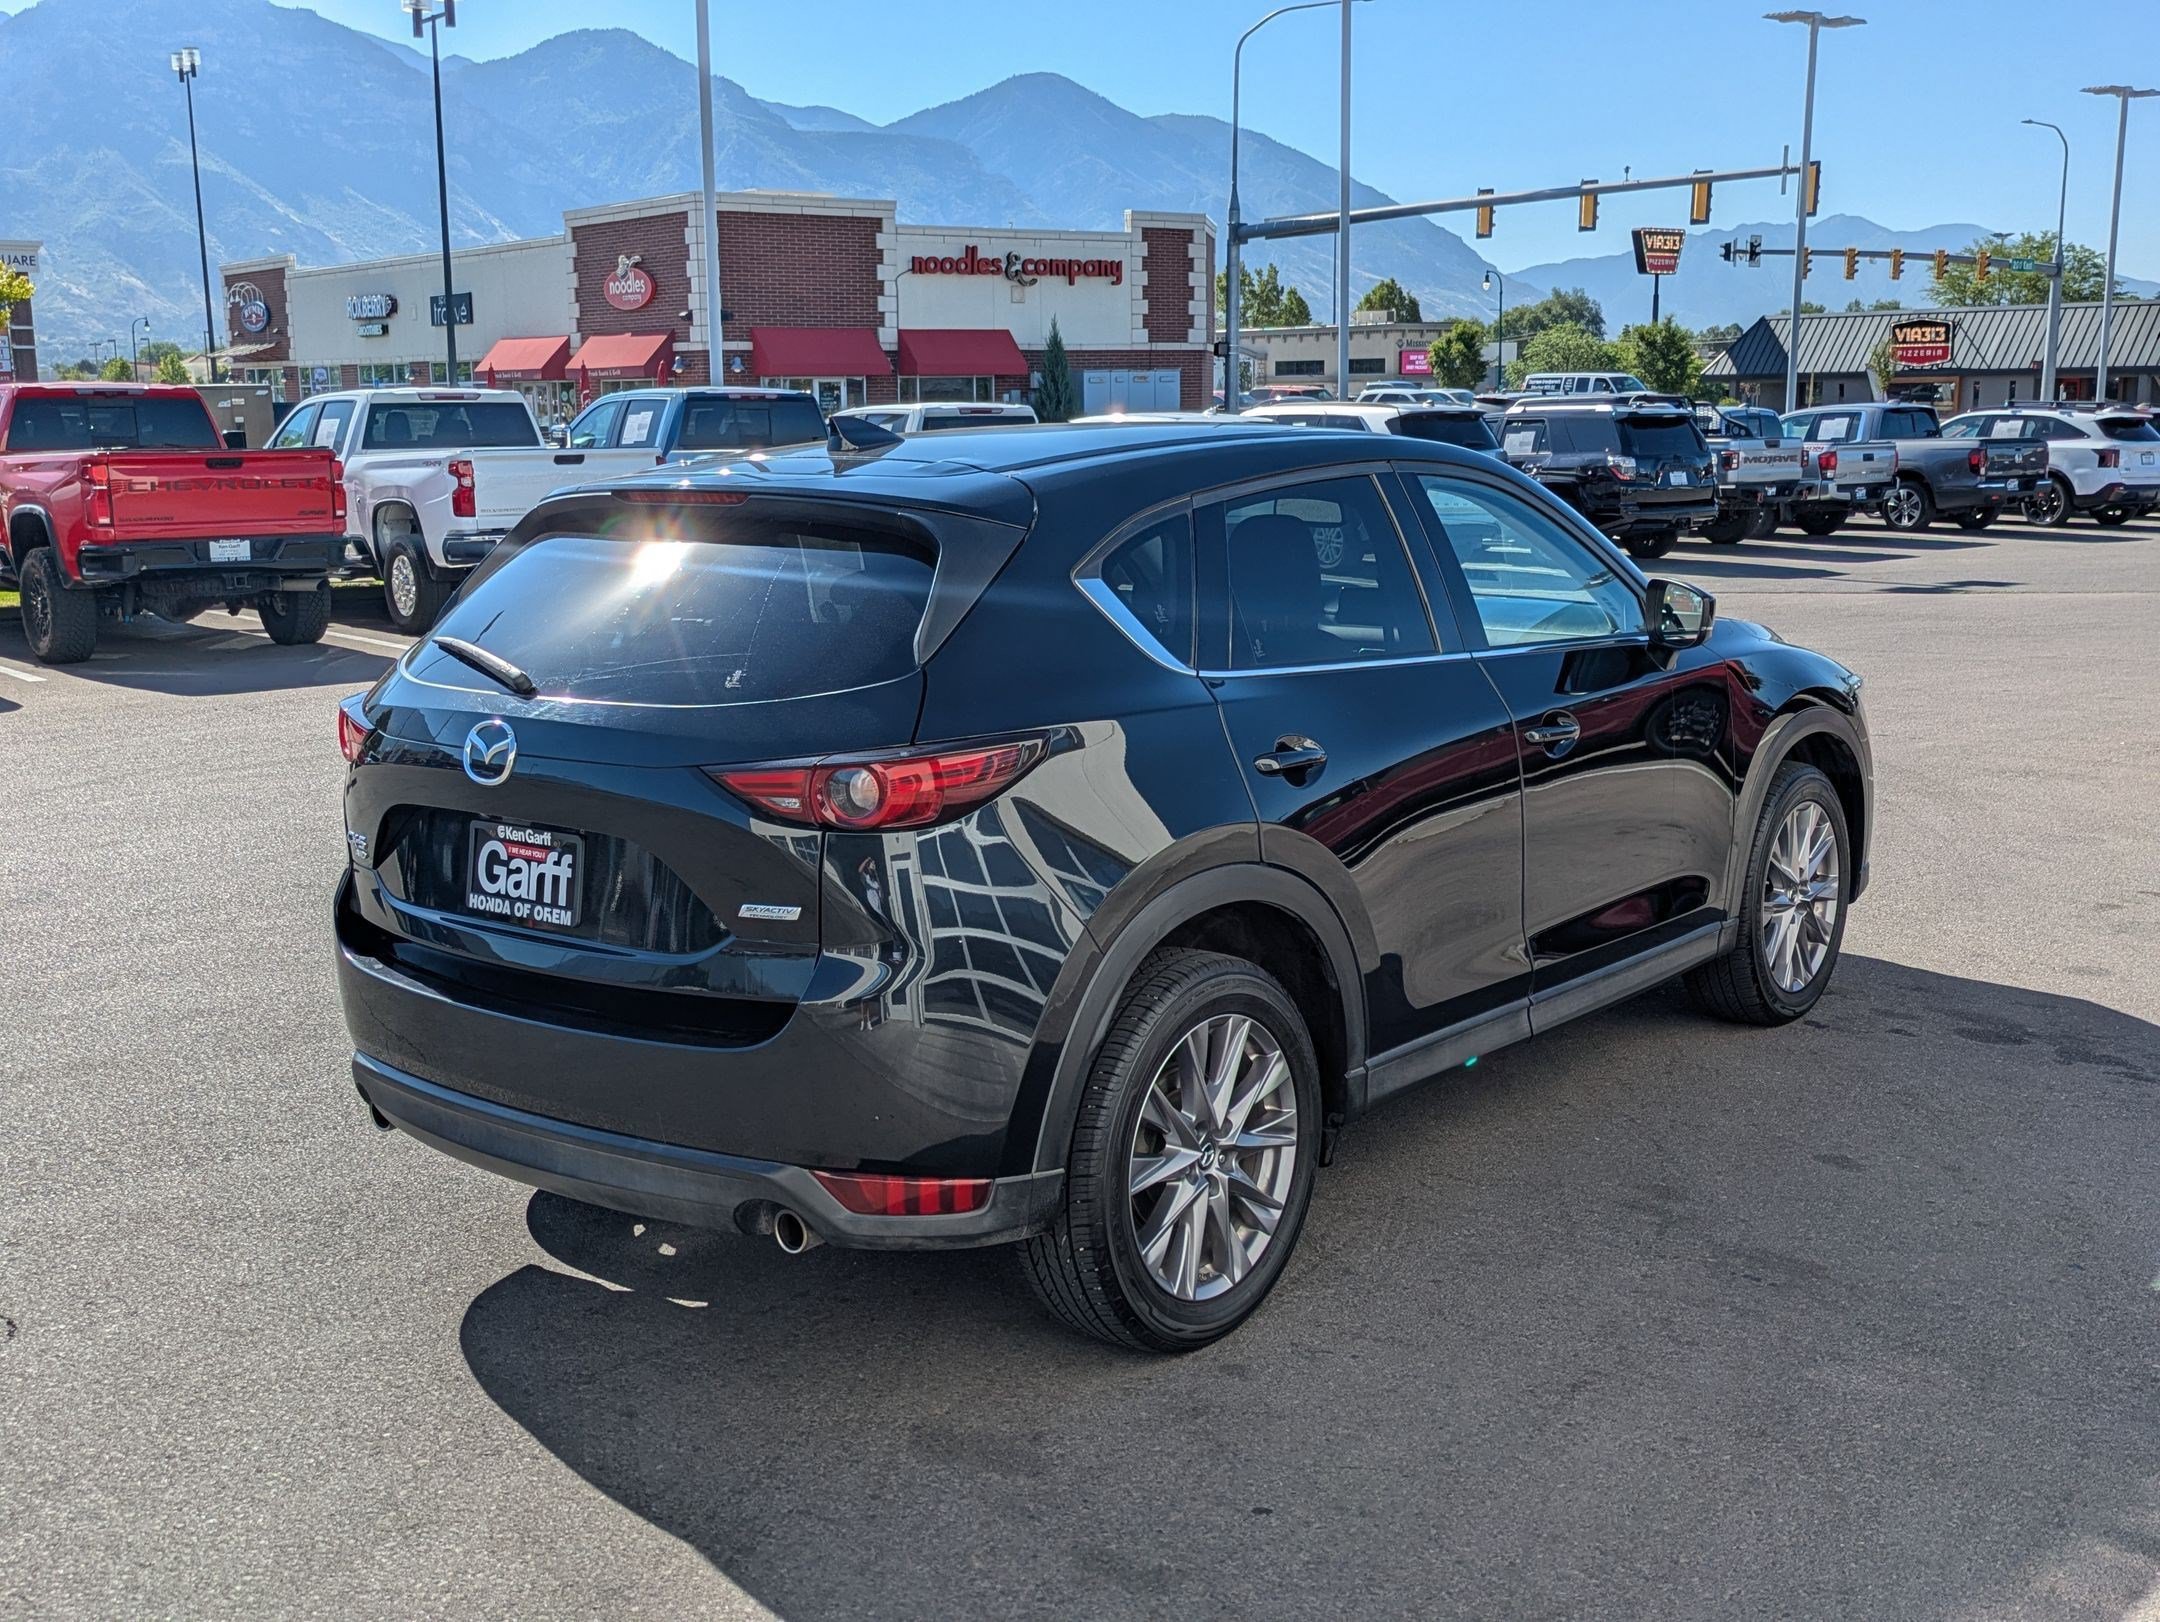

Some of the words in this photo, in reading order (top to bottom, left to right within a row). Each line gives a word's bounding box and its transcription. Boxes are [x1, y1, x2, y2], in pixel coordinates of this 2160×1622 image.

[912, 245, 1002, 275] noodles
[1005, 251, 1038, 286] &
[1021, 257, 1123, 286] company
[609, 271, 646, 295] noodles
[347, 296, 386, 319] ROXBERRY
[1897, 349, 1943, 357] PIZZERIA
[1743, 454, 1799, 465] MOJAVE
[127, 477, 314, 493] CHEVROLET
[506, 825, 525, 843] Ken
[525, 829, 551, 846] Garff
[511, 847, 519, 855] WE
[520, 849, 532, 857] HEAR
[532, 851, 542, 859] YOU
[477, 840, 573, 907] Garff
[469, 893, 511, 916] HONDA
[514, 901, 532, 918] OF
[533, 905, 572, 926] OREM
[745, 906, 796, 914] SKYACTIV
